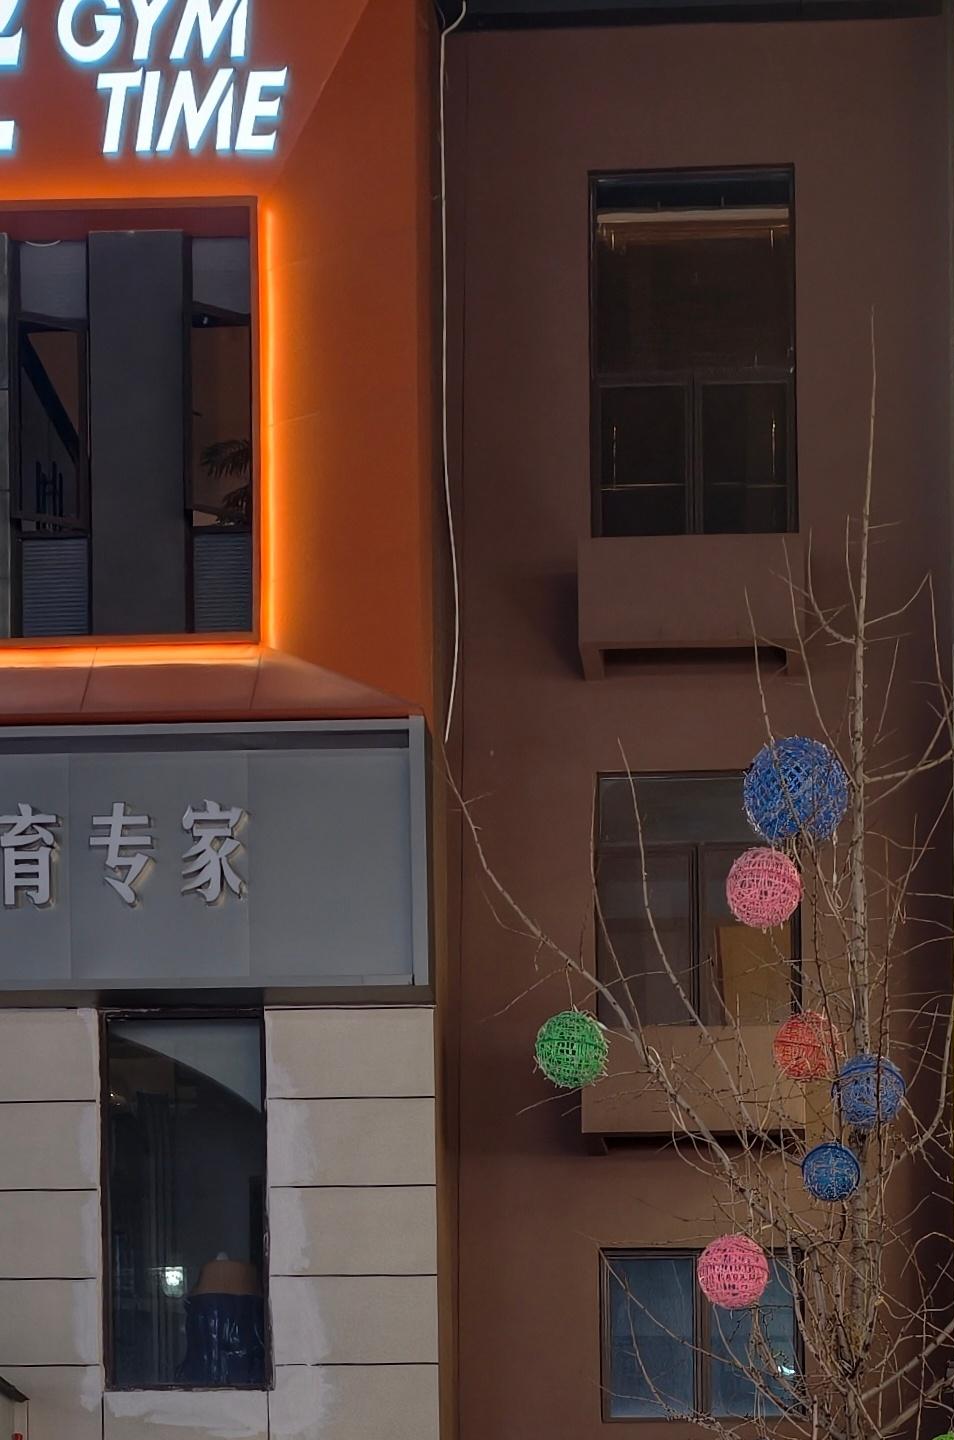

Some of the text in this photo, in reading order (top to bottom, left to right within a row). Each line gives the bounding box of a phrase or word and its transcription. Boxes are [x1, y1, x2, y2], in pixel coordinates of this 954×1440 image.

[57, 0, 248, 62] GYM
[97, 67, 287, 152] TIME
[0, 799, 248, 906] 育专家
